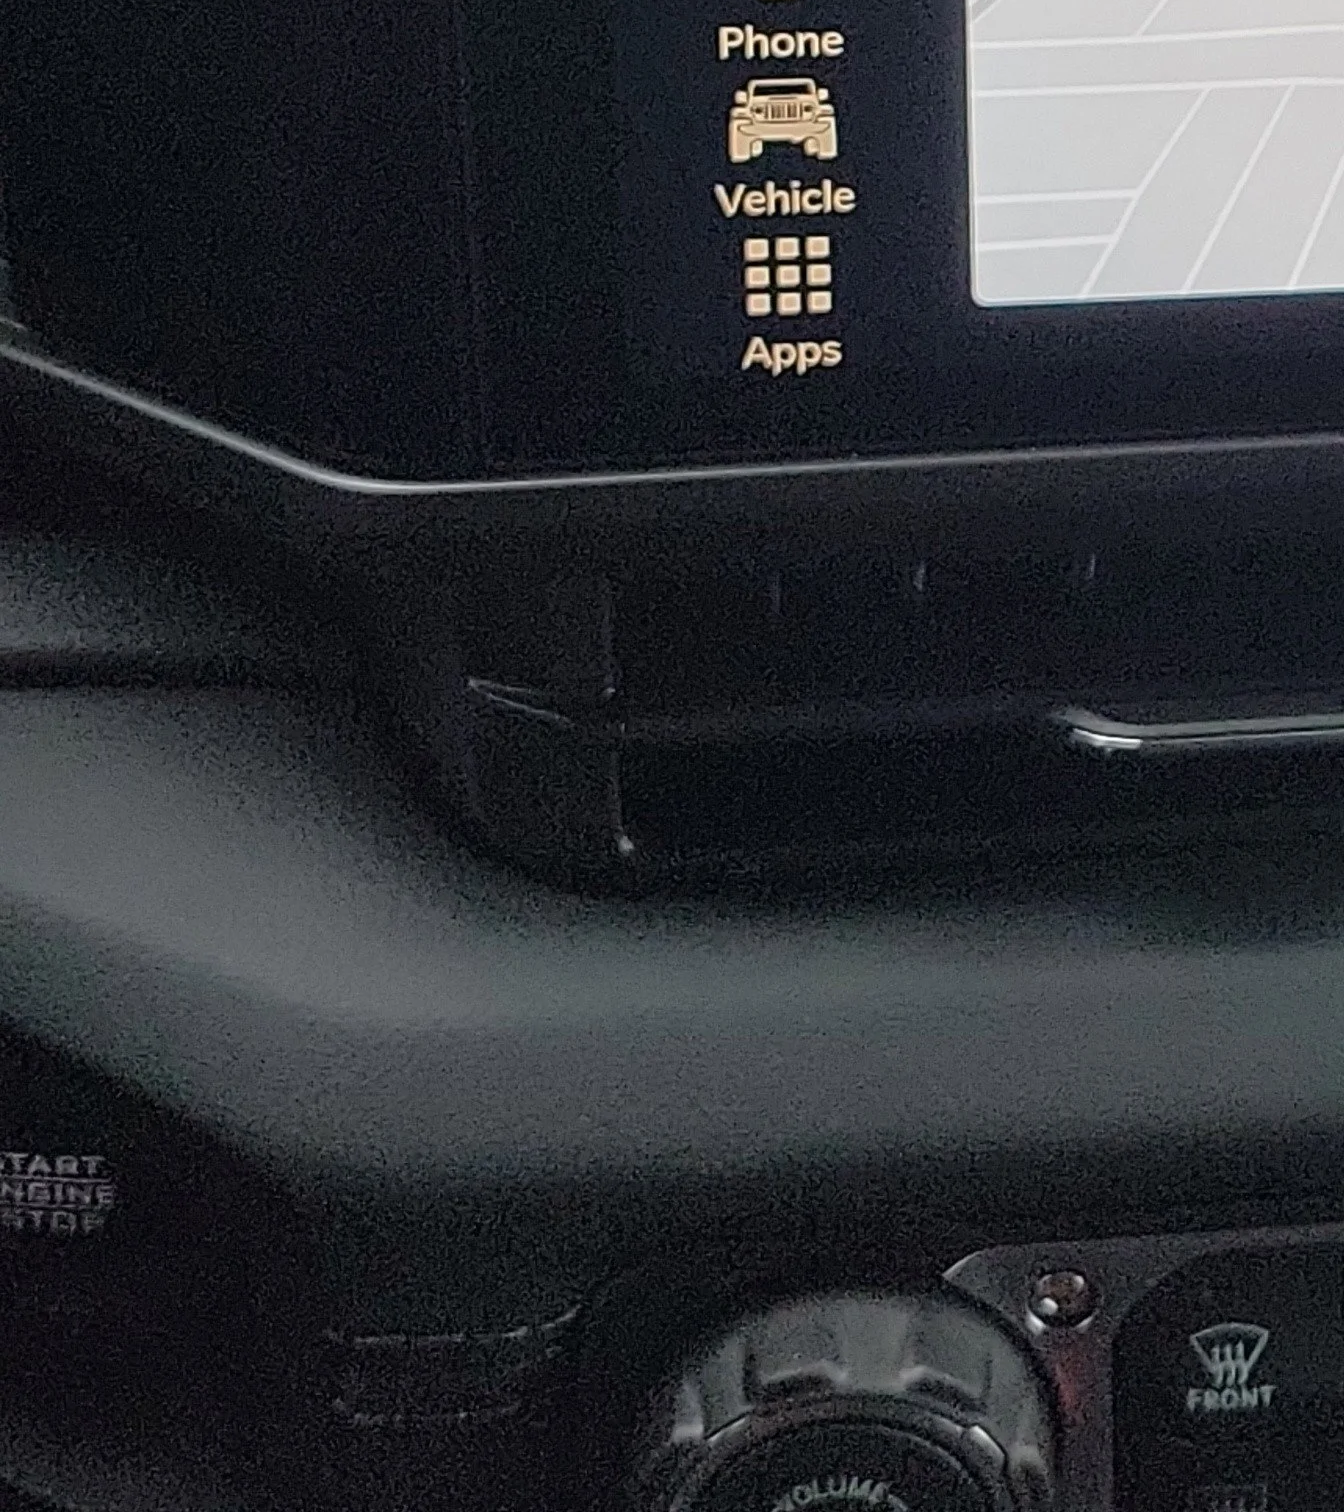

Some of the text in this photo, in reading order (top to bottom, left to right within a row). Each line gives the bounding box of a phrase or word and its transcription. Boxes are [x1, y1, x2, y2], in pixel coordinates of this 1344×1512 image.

[717, 26, 845, 60] Phone
[714, 180, 857, 216] Vehicle
[741, 335, 843, 374] Apps
[0, 1182, 114, 1205] NGINE
[1188, 1385, 1276, 1410] FRONT
